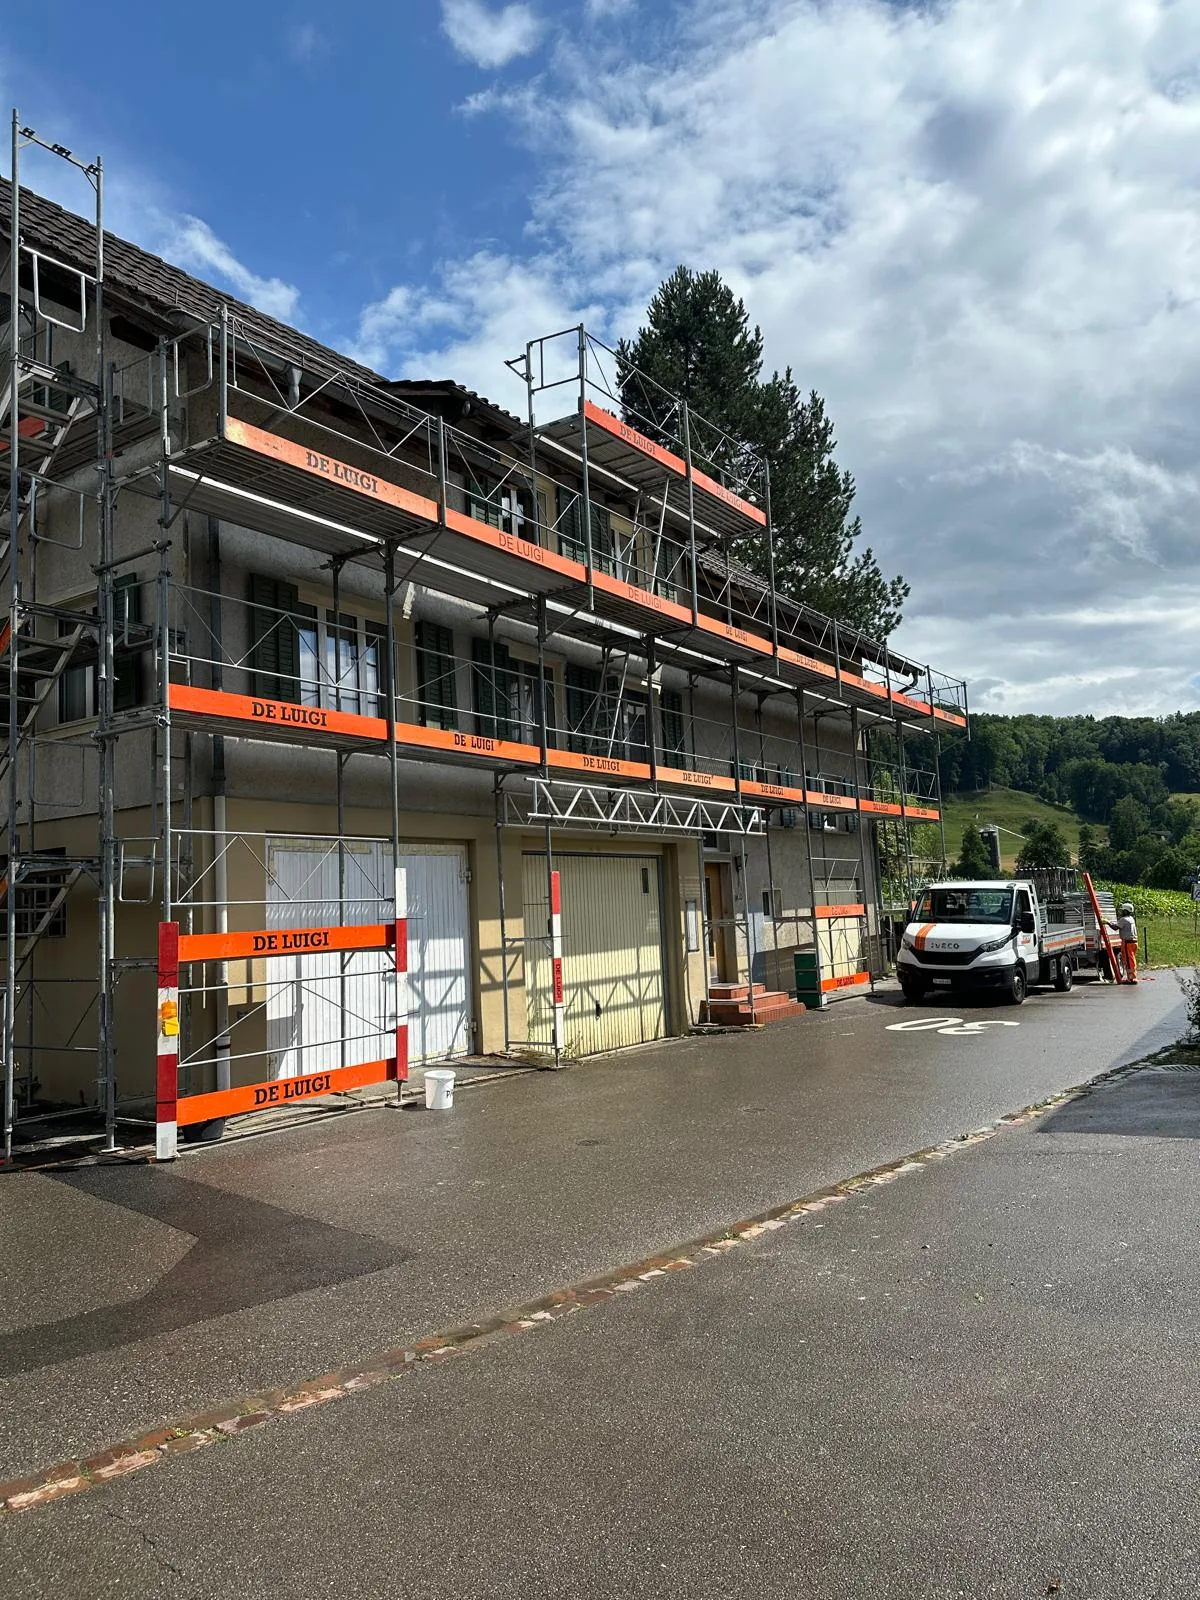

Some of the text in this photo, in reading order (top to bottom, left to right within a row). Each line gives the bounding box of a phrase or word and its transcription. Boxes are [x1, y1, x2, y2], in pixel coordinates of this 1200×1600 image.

[306, 451, 378, 493] DE LUIGI
[499, 533, 544, 562] DE LUIGI
[628, 586, 662, 609] DE LUIGI
[252, 702, 327, 727] DE LUIGI
[454, 733, 494, 752] DE LUIGI
[583, 756, 620, 772] DE LUIGI
[682, 772, 711, 785] DE LUIGI
[253, 932, 329, 951] DE LUIGI
[930, 942, 960, 950] IVECO
[885, 1017, 1020, 1035] 30
[254, 1075, 331, 1105] DE LUIGI
